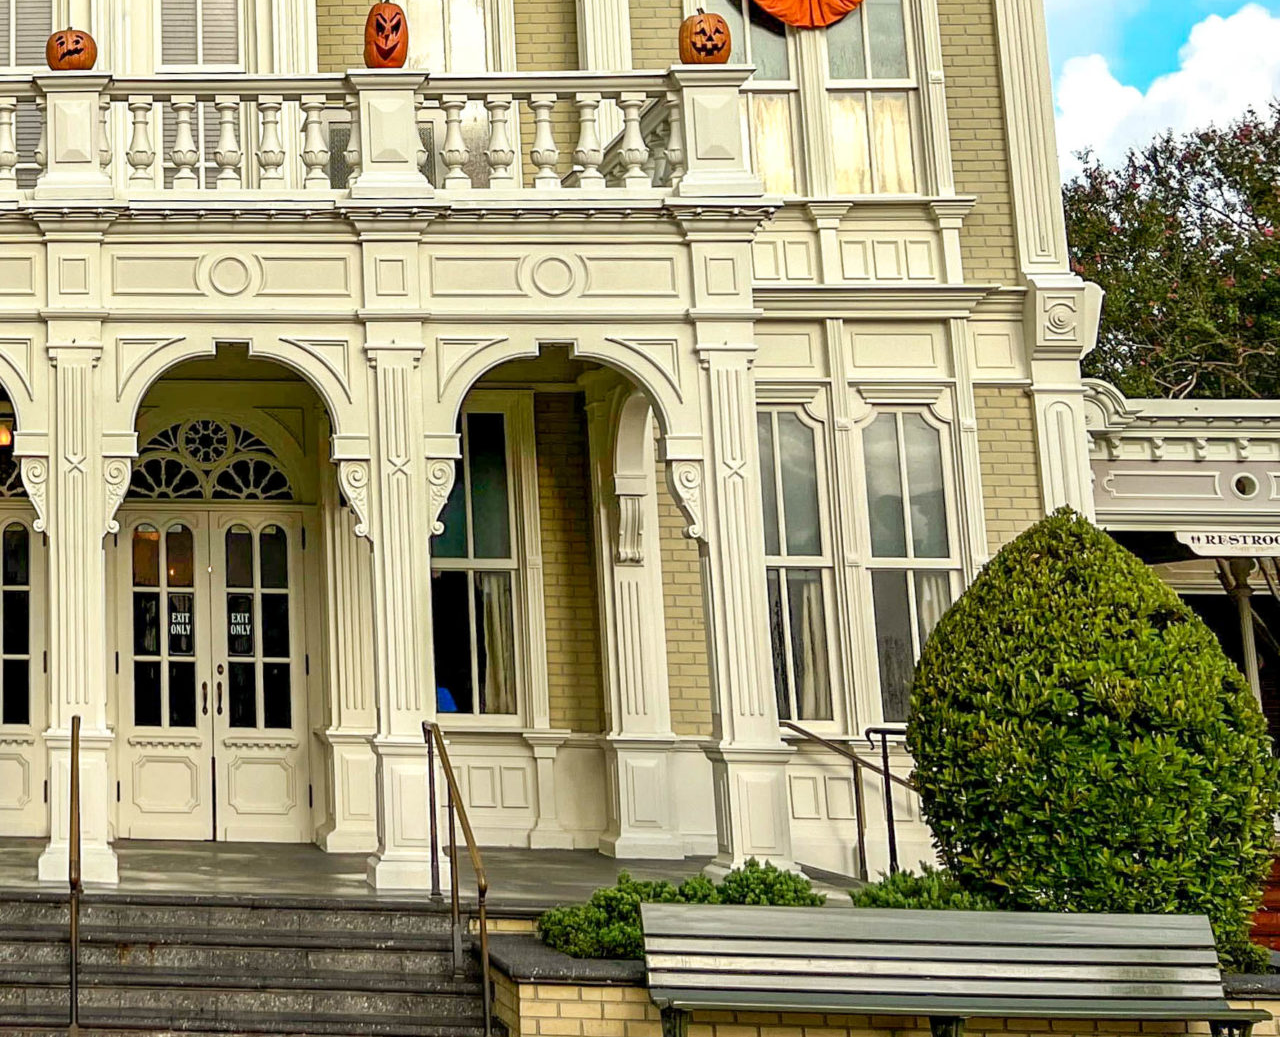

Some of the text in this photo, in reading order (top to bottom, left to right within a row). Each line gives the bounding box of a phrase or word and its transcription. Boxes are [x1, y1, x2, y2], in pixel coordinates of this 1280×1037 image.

[172, 612, 190, 623] EXIT
[231, 613, 250, 623] EXIT
[170, 624, 191, 635] ONLY
[230, 624, 251, 635] ONLY
